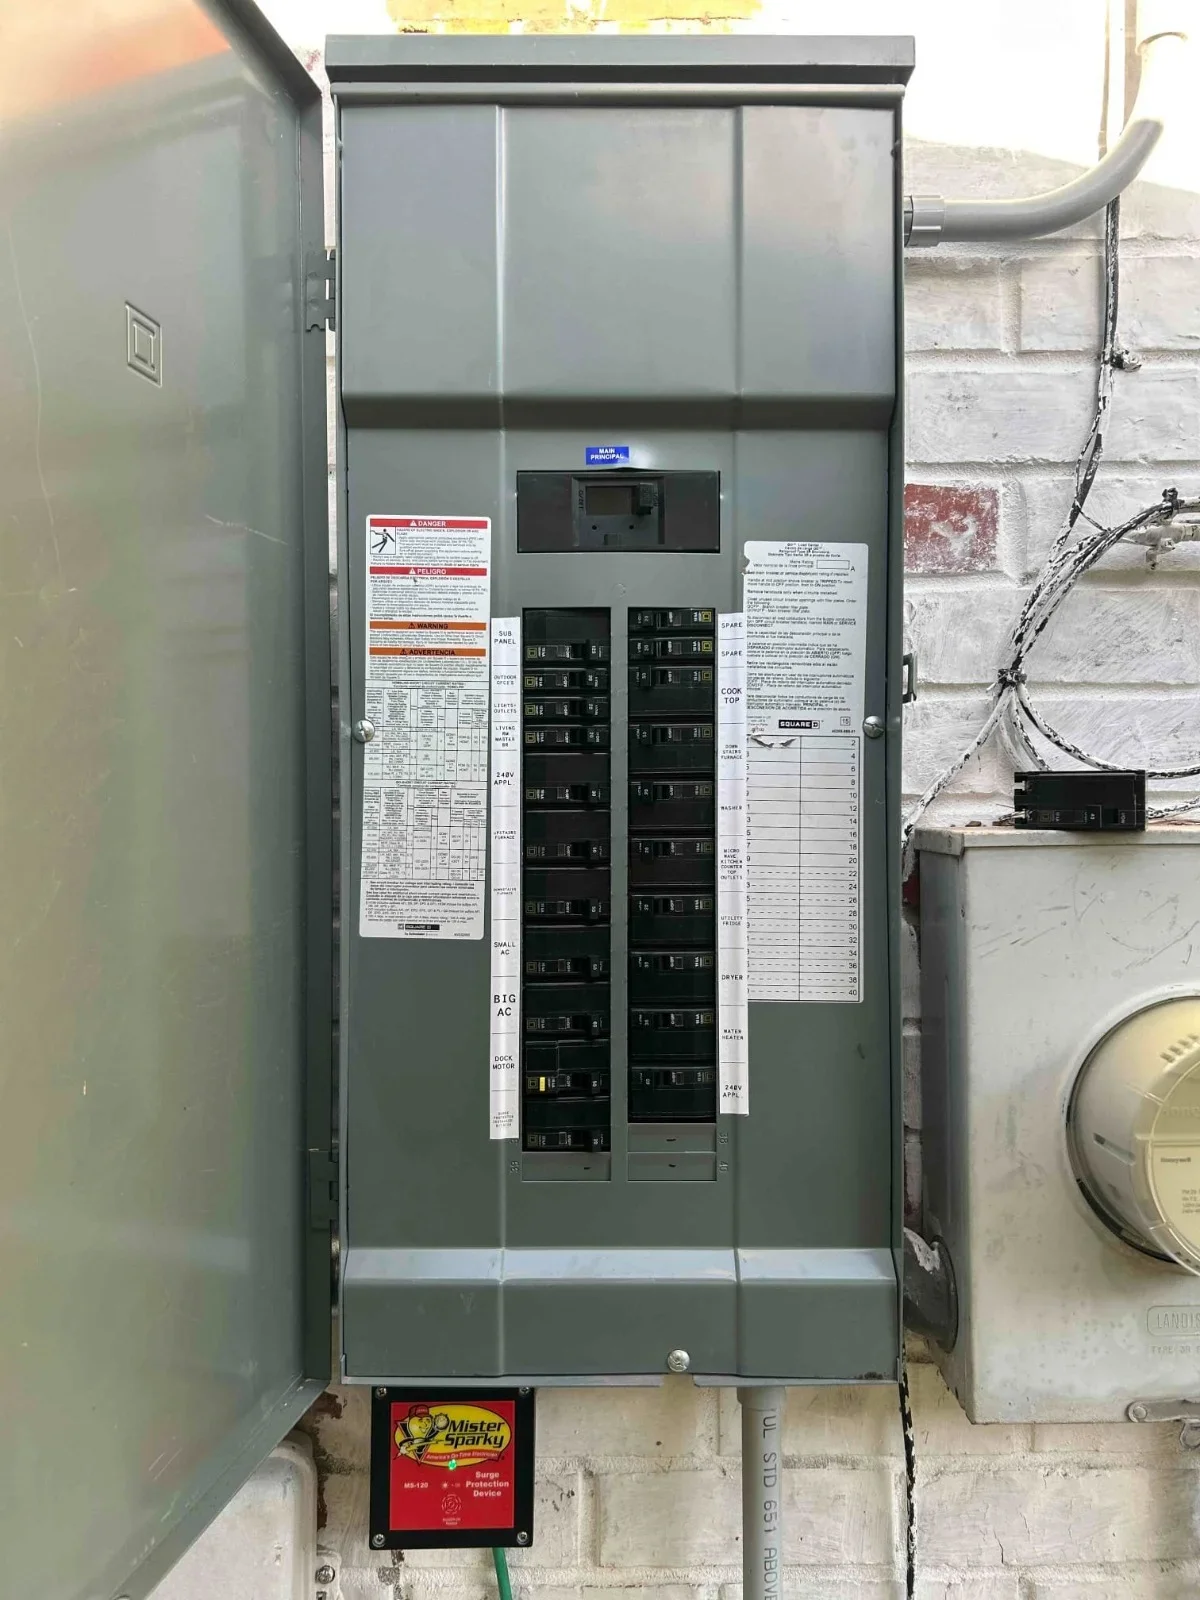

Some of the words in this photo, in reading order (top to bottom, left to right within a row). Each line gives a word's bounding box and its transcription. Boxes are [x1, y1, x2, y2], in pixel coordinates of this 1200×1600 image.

[494, 994, 516, 1003] BIG
[497, 1008, 512, 1016] AC
[448, 1420, 505, 1432] Mister
[763, 1415, 776, 1439] UL
[444, 1432, 504, 1448] Sparky
[763, 1452, 777, 1488] STD
[764, 1500, 777, 1532] 651
